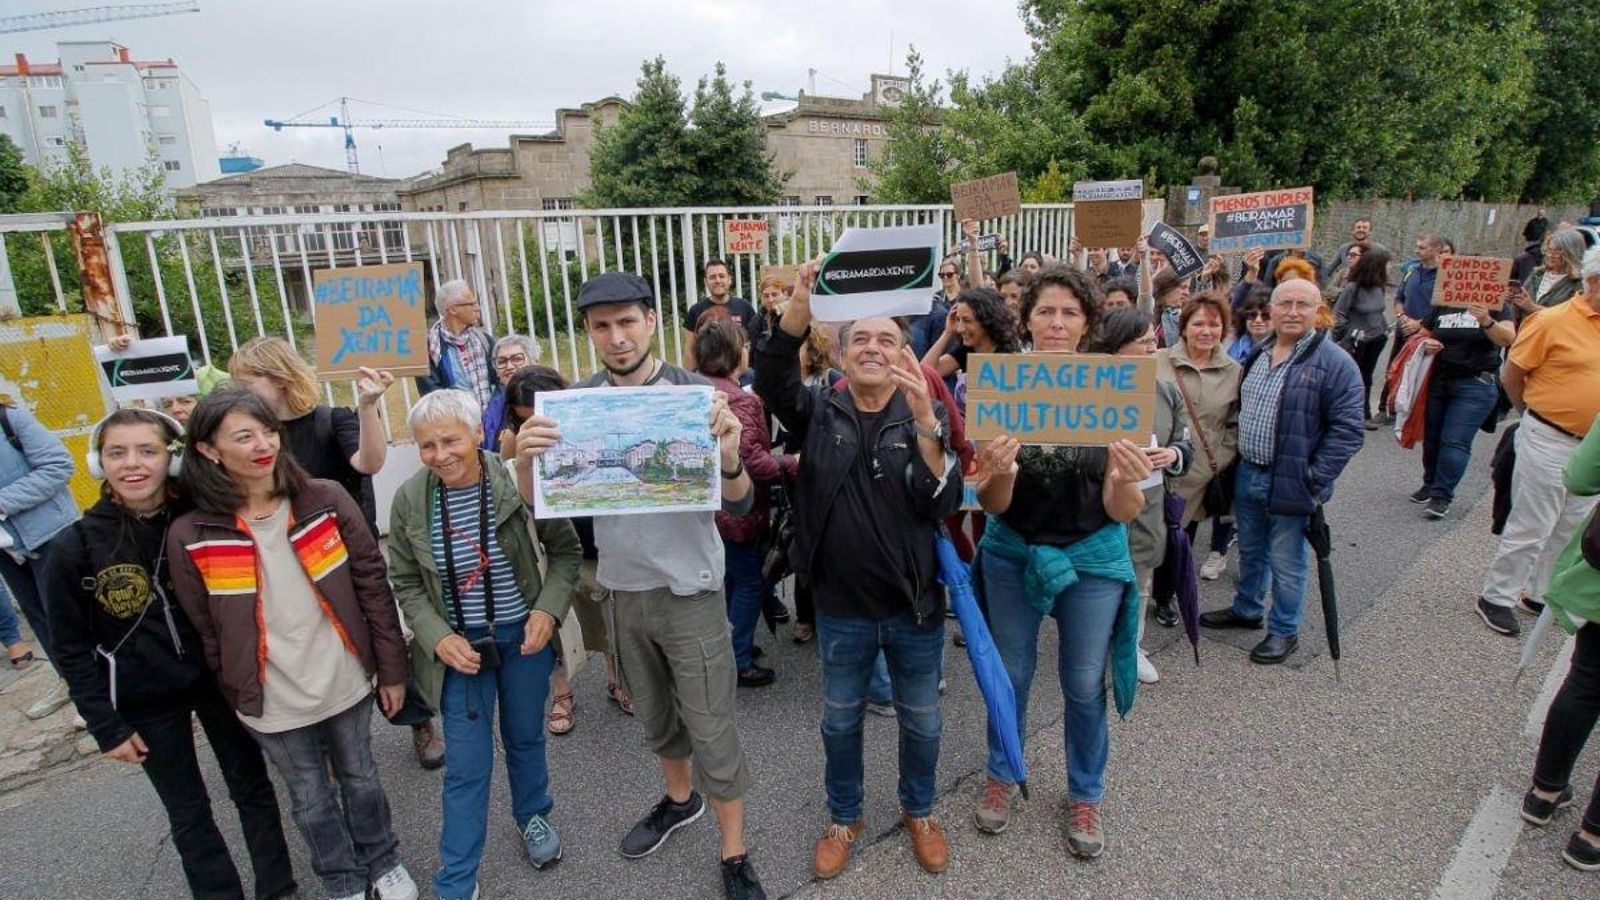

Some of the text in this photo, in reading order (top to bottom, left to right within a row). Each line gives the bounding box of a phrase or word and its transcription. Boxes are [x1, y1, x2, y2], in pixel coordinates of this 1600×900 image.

[1213, 191, 1310, 212] MENOS DUPLEX
[1226, 207, 1296, 222] #BEIRAMAR
[1254, 217, 1294, 231] XENTE
[740, 232, 753, 241] DA
[729, 240, 764, 251] XENTE
[1442, 258, 1501, 271] FONDOS
[825, 265, 916, 280] #BEIRAMARDAXENTE
[1446, 271, 1498, 281] VOITRE
[1444, 291, 1502, 304] BARRIOS
[357, 304, 392, 328] DA
[330, 326, 411, 365] XENTE
[977, 361, 1138, 392] ALFAGEME
[976, 402, 1140, 432] MULTIUSOS
